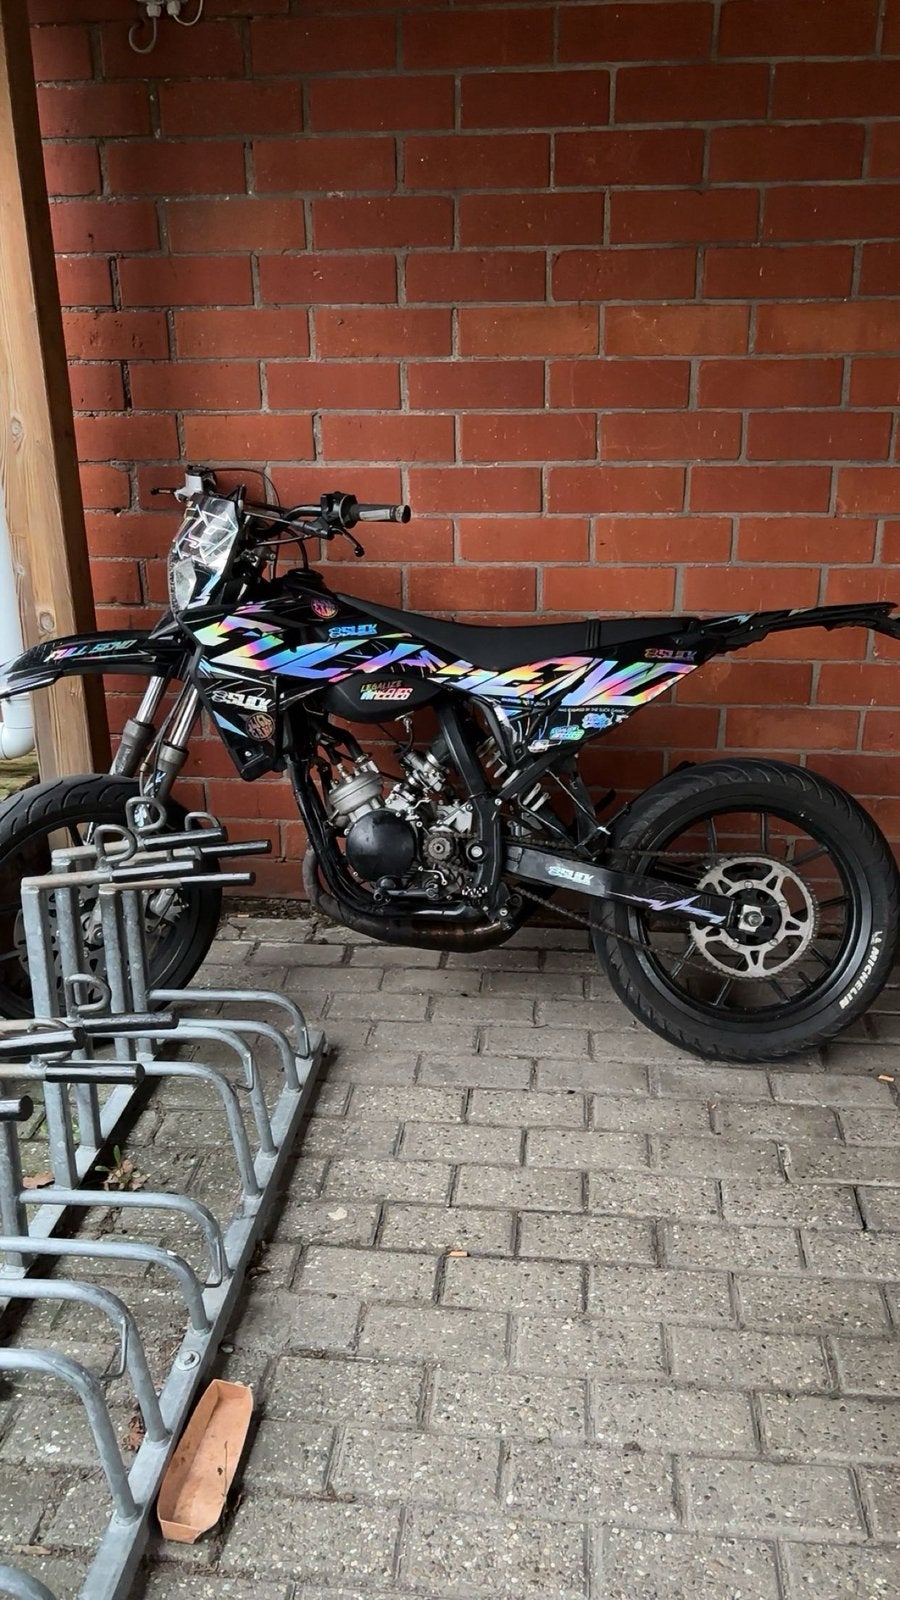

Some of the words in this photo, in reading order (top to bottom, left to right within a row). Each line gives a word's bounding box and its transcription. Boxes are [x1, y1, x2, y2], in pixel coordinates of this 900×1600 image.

[89, 639, 138, 653] SEND
[360, 679, 402, 693] LEGALIZE
[839, 946, 880, 1010] MICHELIN
